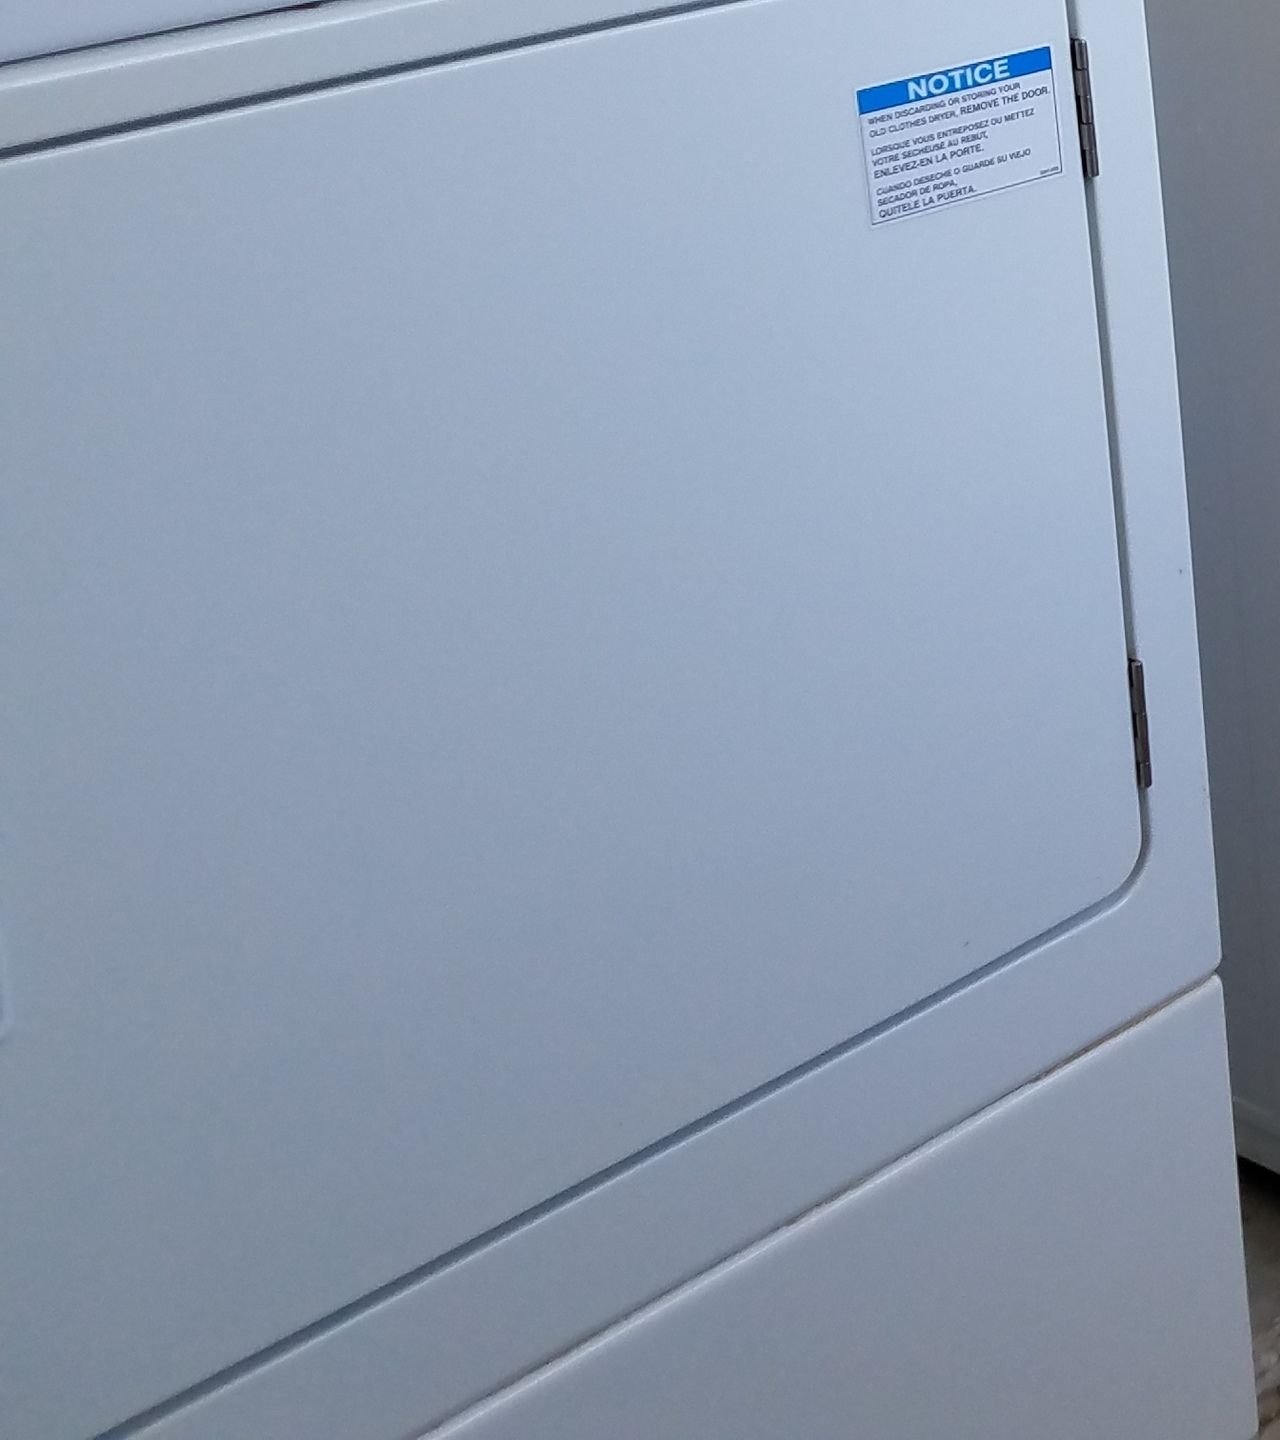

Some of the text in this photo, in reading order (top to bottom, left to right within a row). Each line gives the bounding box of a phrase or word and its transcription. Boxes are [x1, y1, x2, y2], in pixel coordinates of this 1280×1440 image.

[907, 58, 1010, 100] NOTICE
[867, 81, 1021, 125] WHEN DISCARDING OR STORING YOUR
[869, 127, 887, 138] OLD
[888, 117, 927, 133] CLOTHES
[960, 98, 1000, 115] REMOVE
[1002, 92, 1020, 106] THE
[1021, 86, 1051, 101] DOOR.
[871, 107, 1034, 156] LORSQUE VOUS ENTREPOSEZ OU METTEZ
[872, 153, 901, 167] VOTRE
[947, 137, 959, 147] AU
[874, 143, 985, 179] ENLEVEZ-EN LA PORTE.
[876, 148, 1031, 196] CUANDO DESECHE O GUARDE SU VIEJO
[877, 189, 918, 207] SECADOR
[919, 185, 931, 196] DE
[879, 185, 977, 218] QUITELE LA PUERTA.
